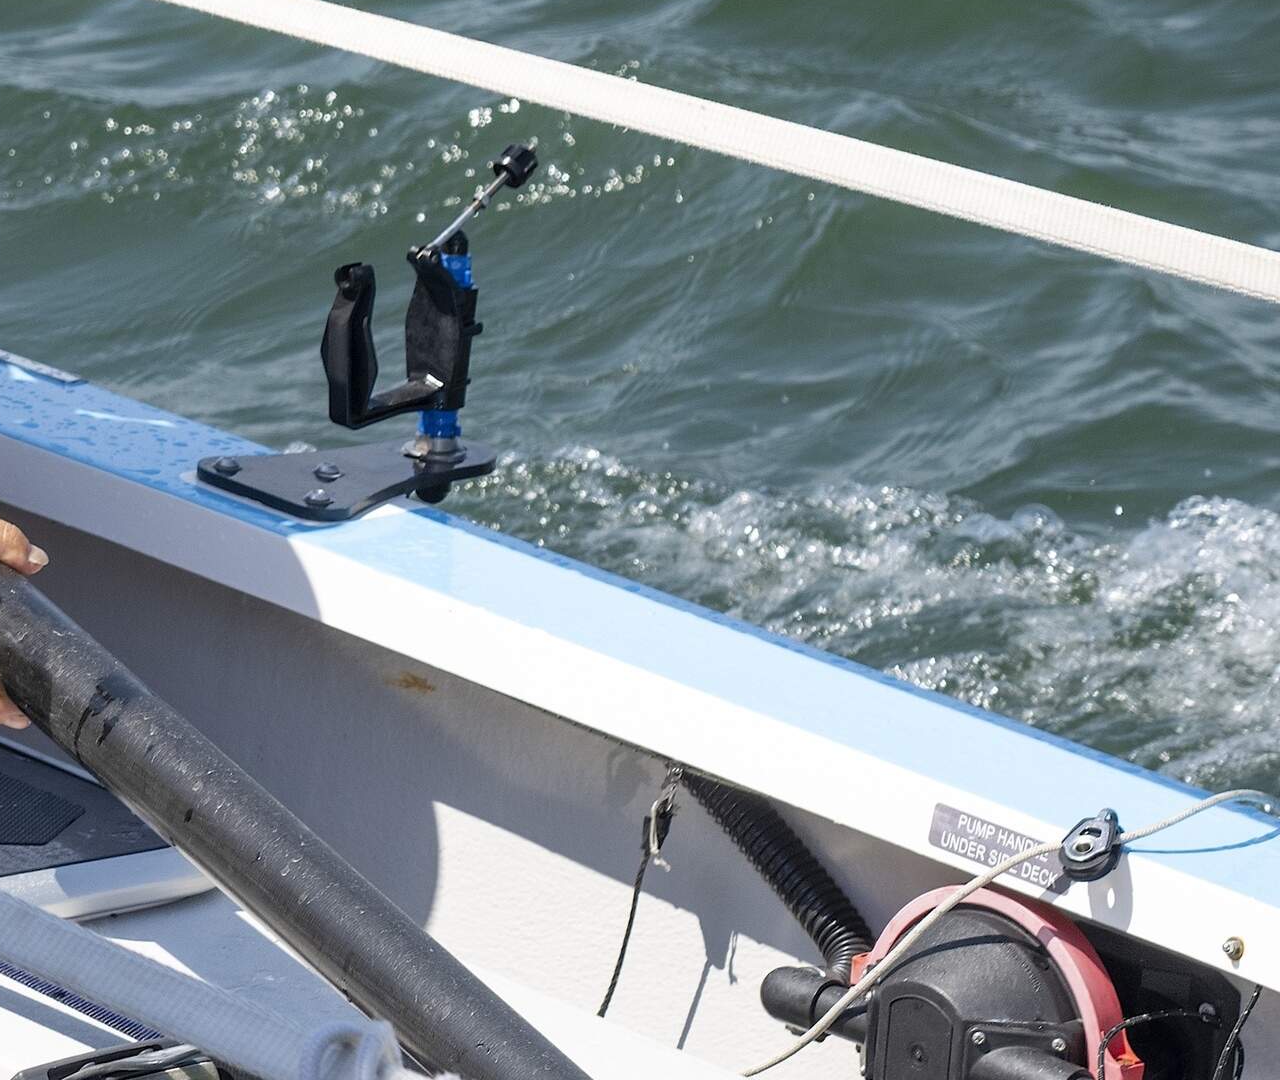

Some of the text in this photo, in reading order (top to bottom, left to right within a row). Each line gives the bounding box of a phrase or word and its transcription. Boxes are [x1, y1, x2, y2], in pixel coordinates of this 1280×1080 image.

[940, 831, 985, 862] UNDER
[1021, 862, 1059, 889] DECK
[958, 814, 1049, 863] PUMP HANDE
